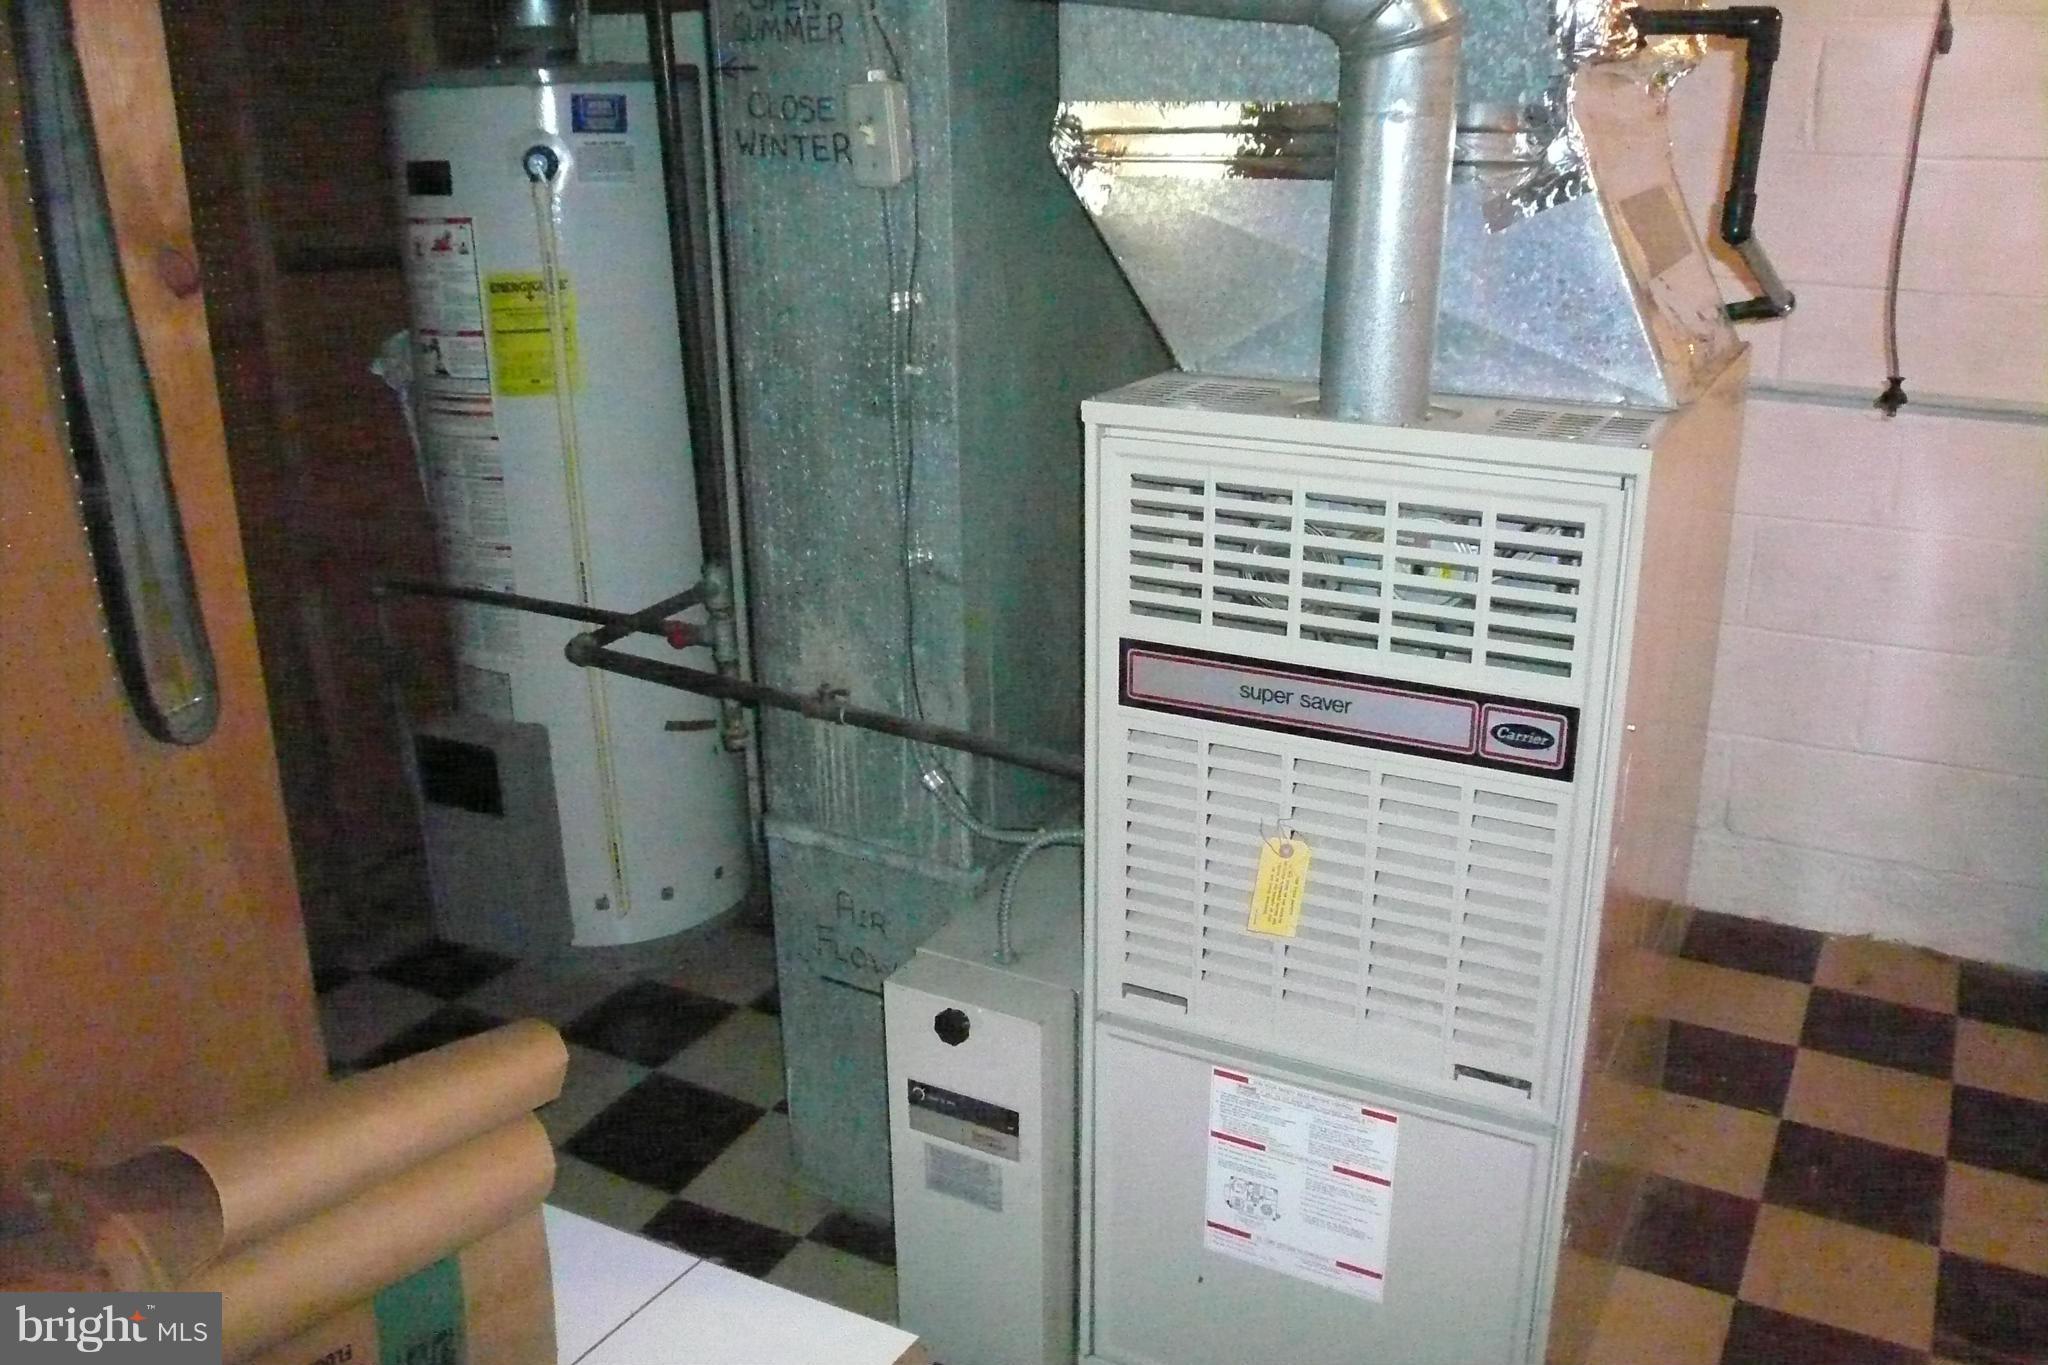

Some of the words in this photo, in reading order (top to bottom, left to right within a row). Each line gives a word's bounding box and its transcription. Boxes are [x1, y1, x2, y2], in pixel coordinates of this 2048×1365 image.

[733, 11, 844, 45] SUMMER
[748, 91, 836, 123] CLOSE
[735, 129, 853, 165] WINTER
[1240, 685, 1295, 705] super
[1300, 694, 1353, 714] saver
[1496, 726, 1550, 746] Carrier
